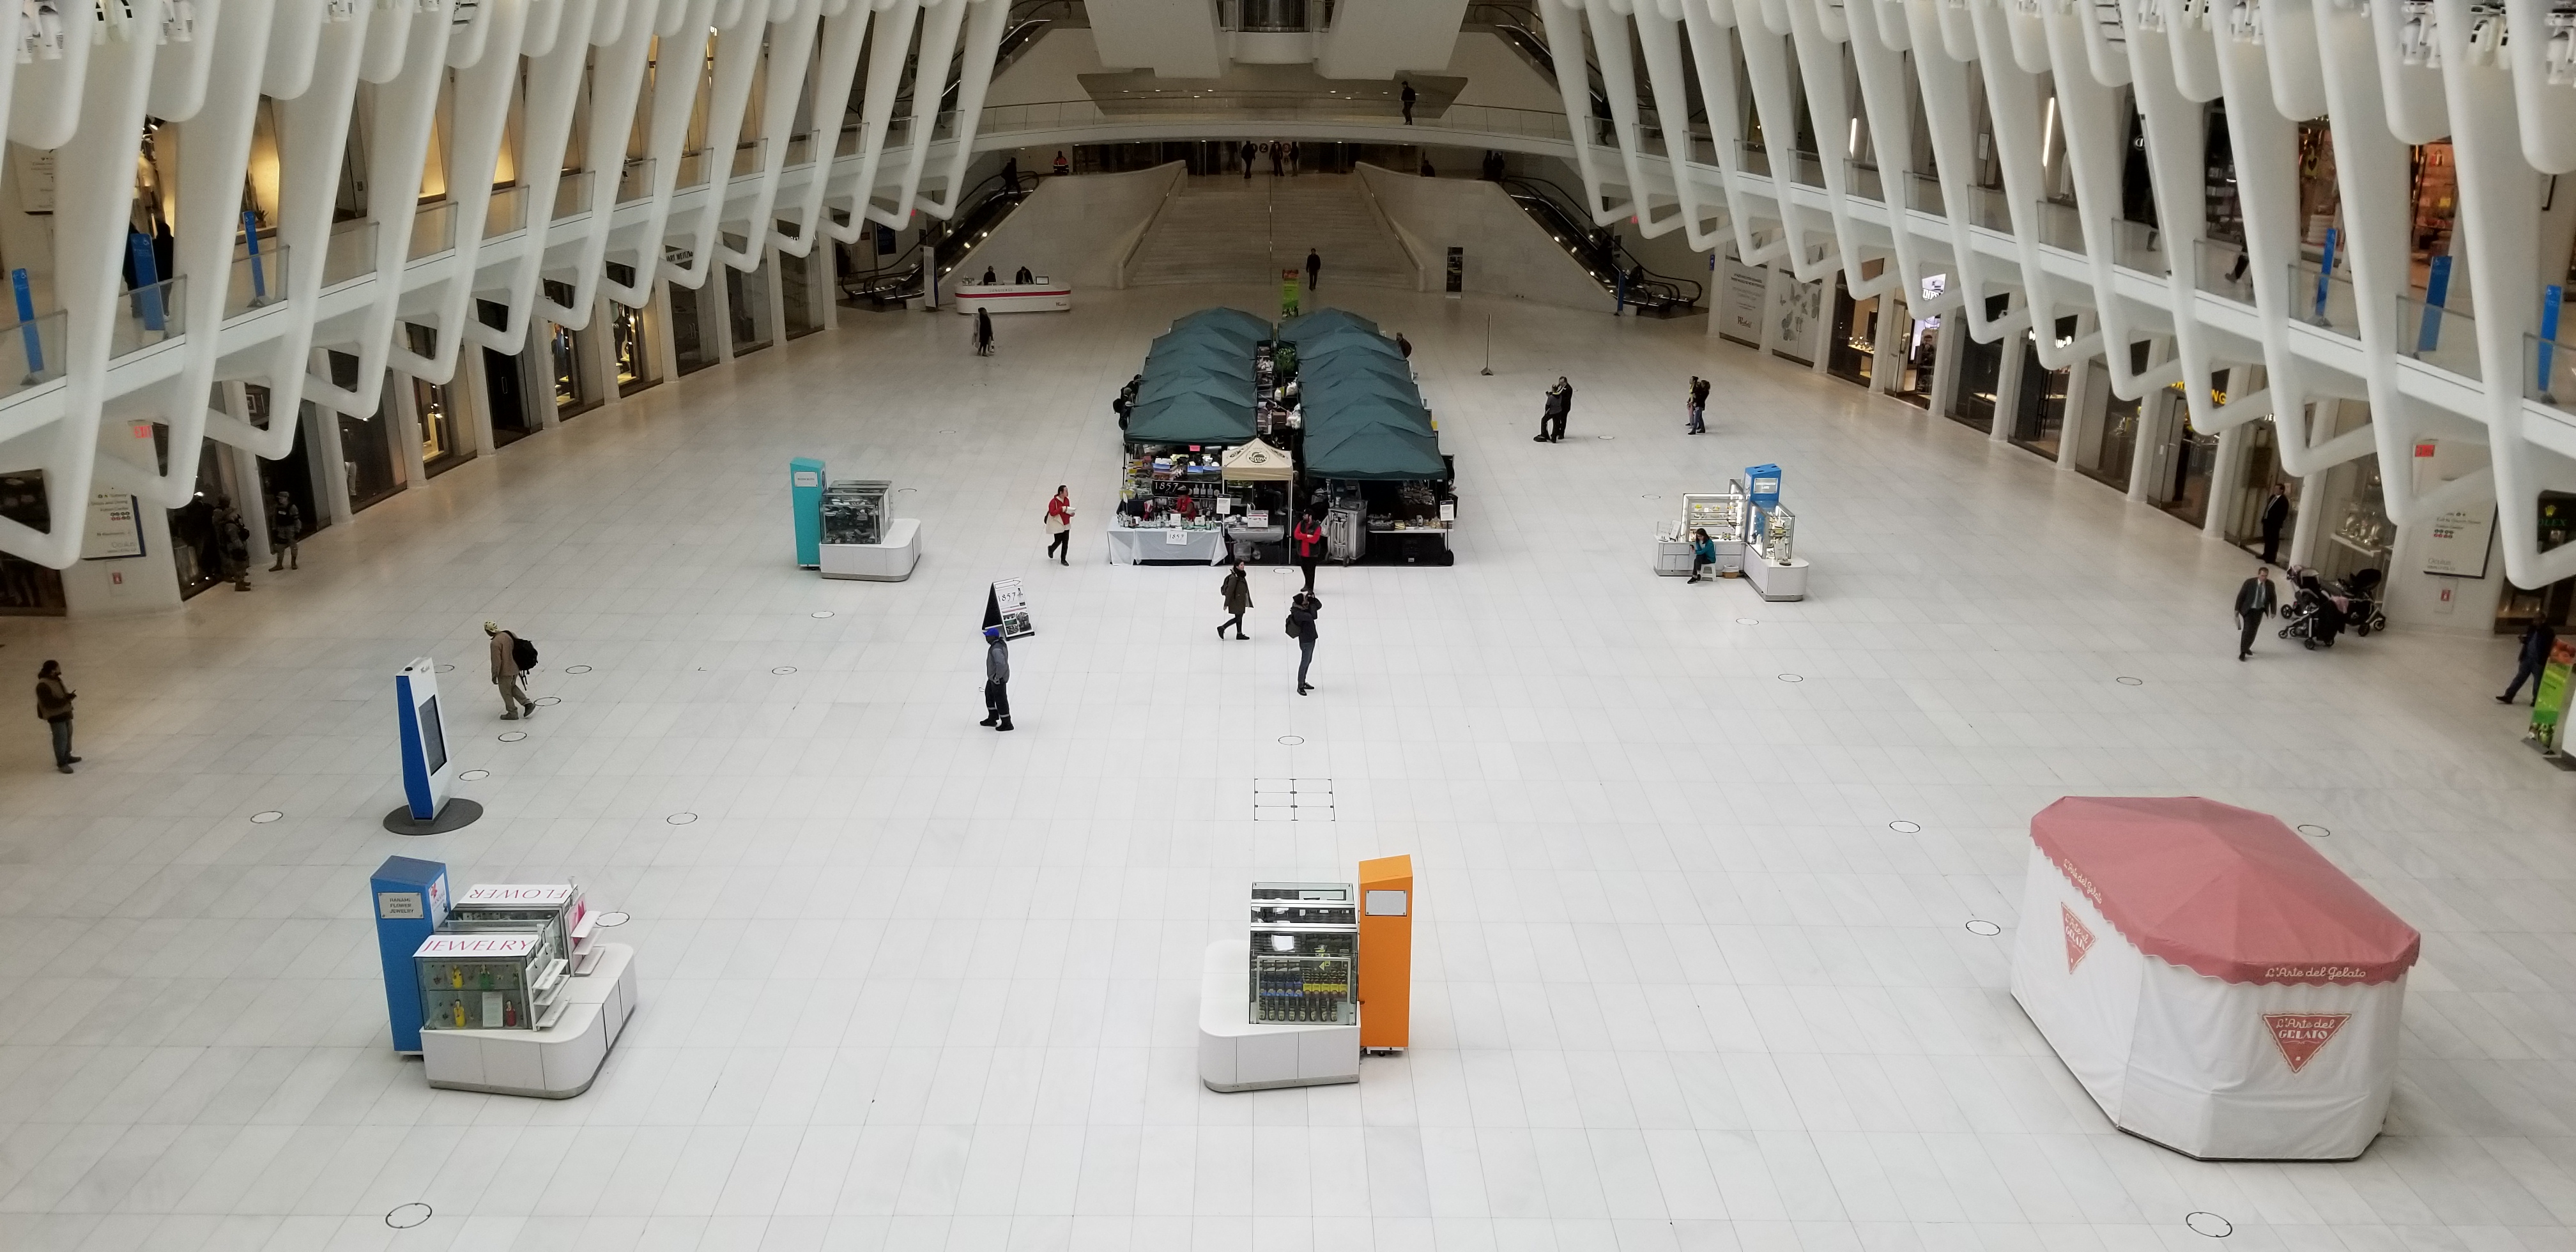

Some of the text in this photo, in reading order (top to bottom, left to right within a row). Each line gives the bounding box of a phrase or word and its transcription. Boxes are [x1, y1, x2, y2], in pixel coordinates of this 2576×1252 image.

[1154, 483, 1179, 492] 1857
[998, 592, 1016, 602] 1857
[469, 889, 568, 899] FLOWER
[421, 940, 535, 952] JEWELRY
[2265, 966, 2366, 980] L'Arte del Gelato
[2276, 1018, 2335, 1029] L'Arte del
[2278, 1030, 2328, 1040] GELATO
